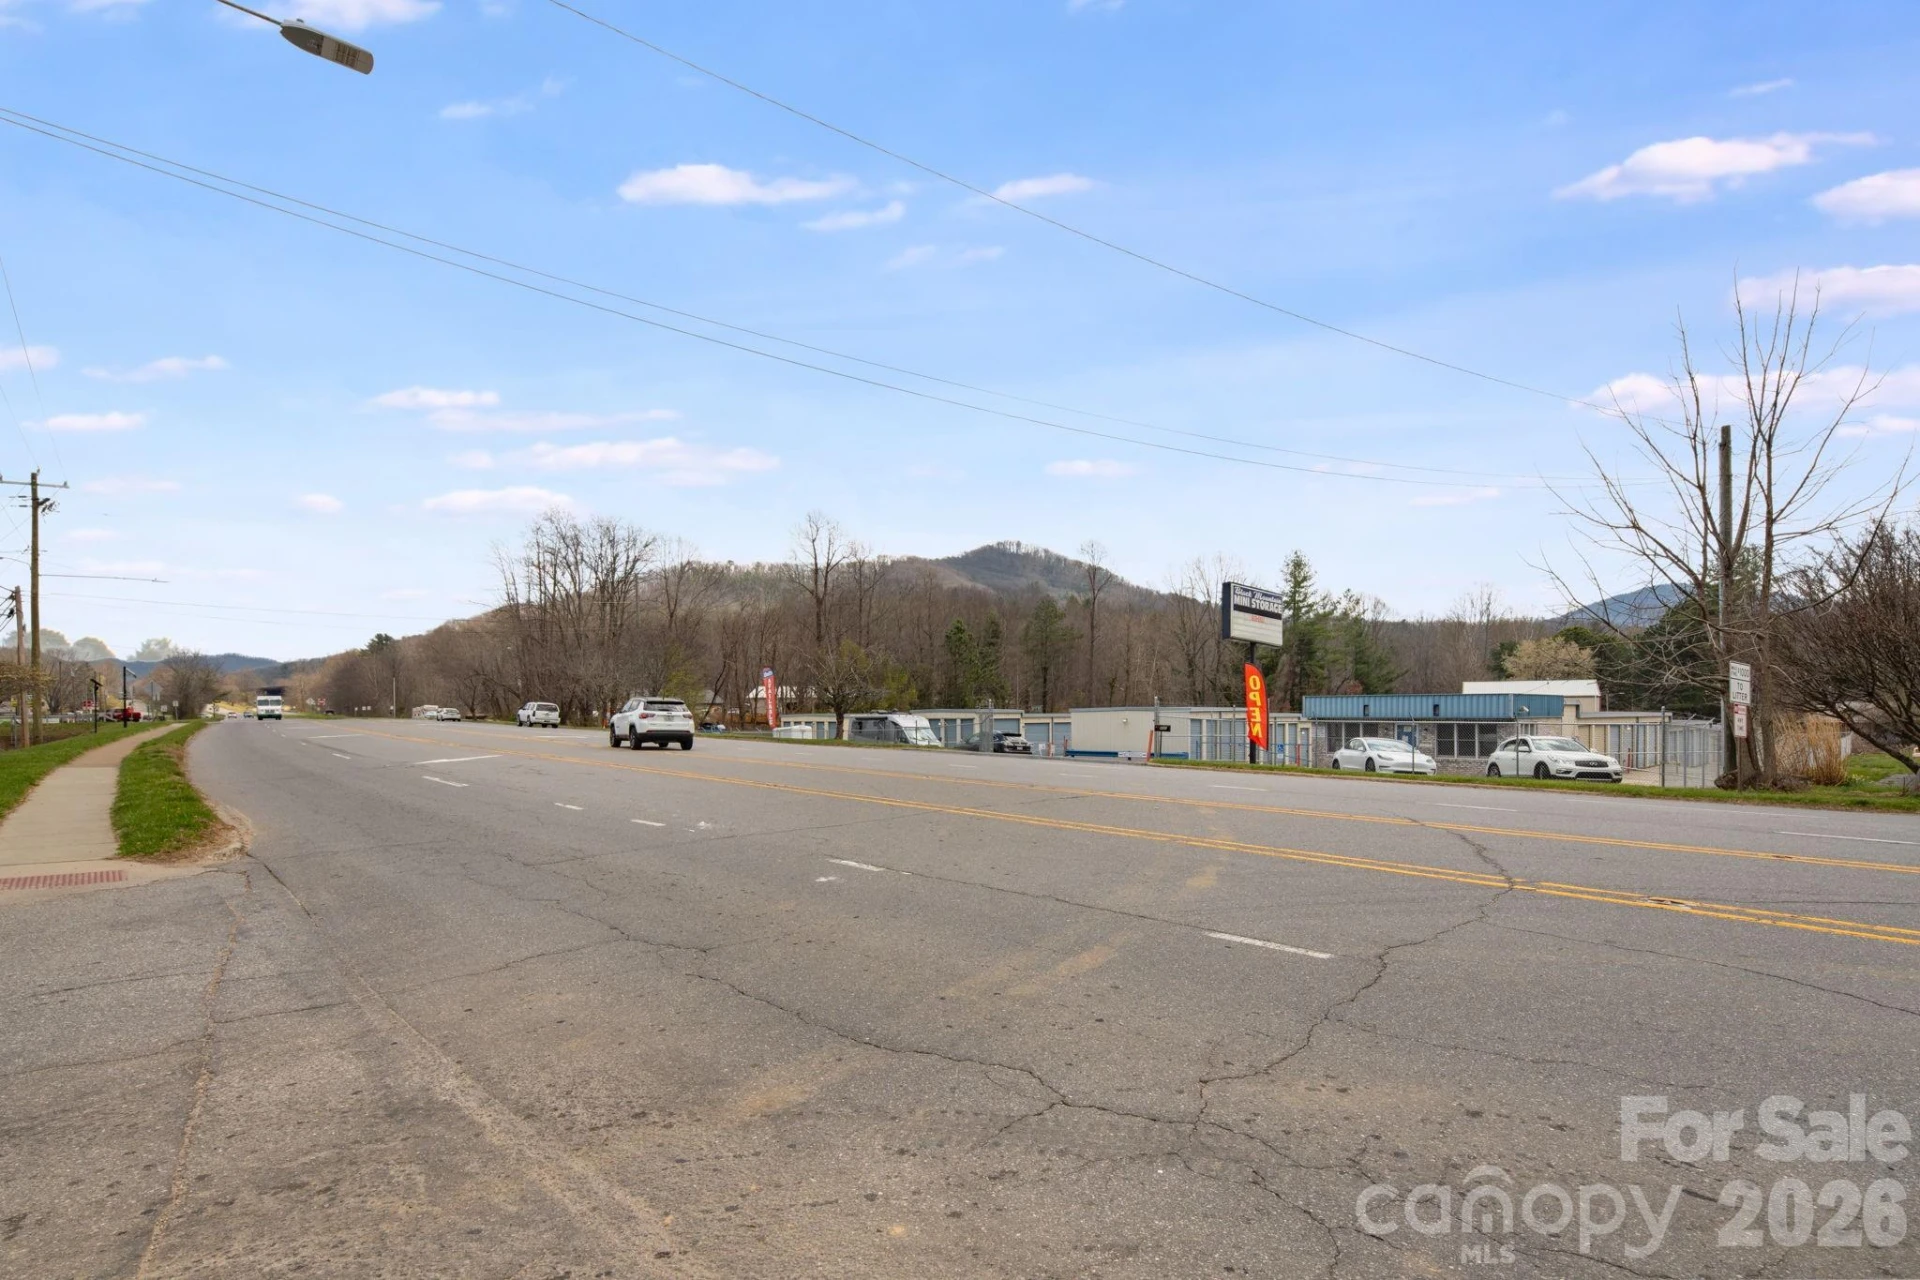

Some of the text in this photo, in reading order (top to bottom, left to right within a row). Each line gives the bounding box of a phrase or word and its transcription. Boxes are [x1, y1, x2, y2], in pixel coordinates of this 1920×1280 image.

[1234, 586, 1252, 598] Black
[1234, 594, 1282, 614] MINI STORAGE
[1737, 682, 1743, 691] TO
[1732, 692, 1748, 701] LITTER
